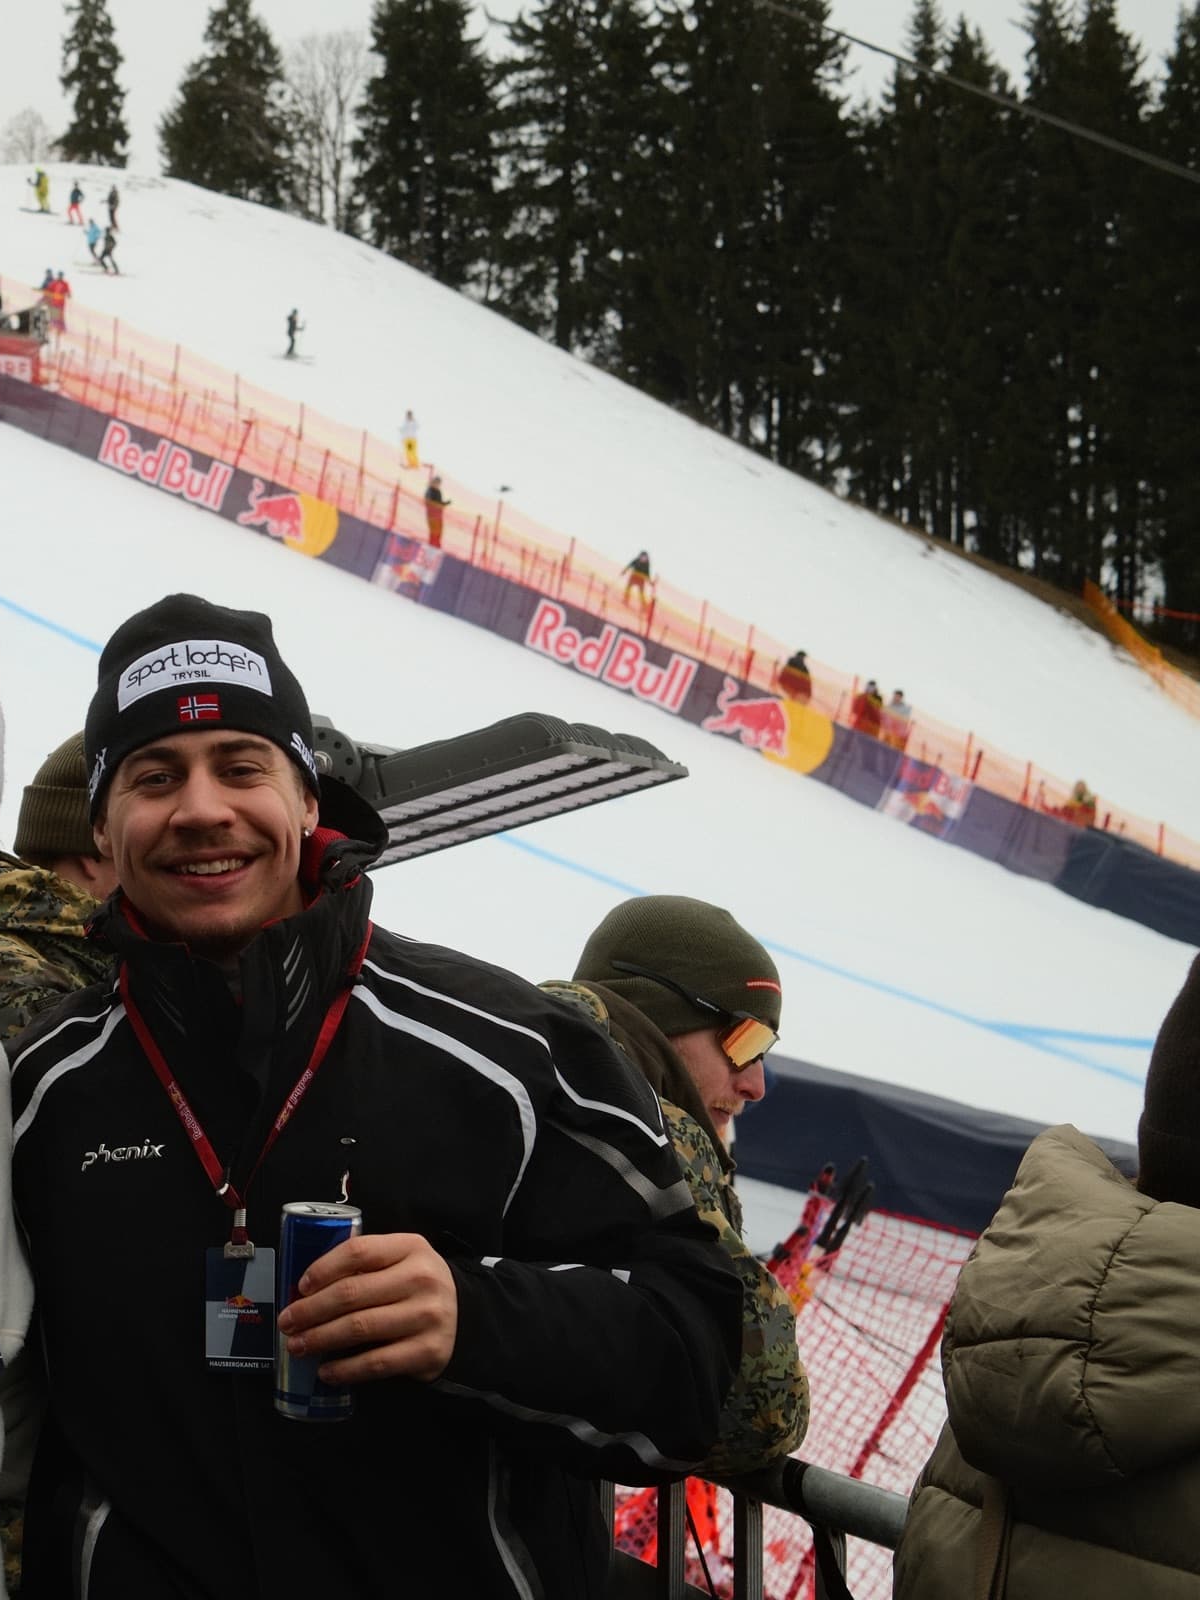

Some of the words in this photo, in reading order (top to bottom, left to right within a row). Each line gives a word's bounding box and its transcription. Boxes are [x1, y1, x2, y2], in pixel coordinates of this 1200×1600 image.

[98, 419, 171, 485] Red
[159, 444, 234, 512] Bull
[126, 647, 179, 688] sport
[525, 598, 618, 679] Red
[601, 631, 699, 714] Bull
[171, 669, 211, 681] TRYSIL
[81, 1138, 166, 1172] phenix
[209, 1360, 259, 1368] HAUSBERGKANTE
